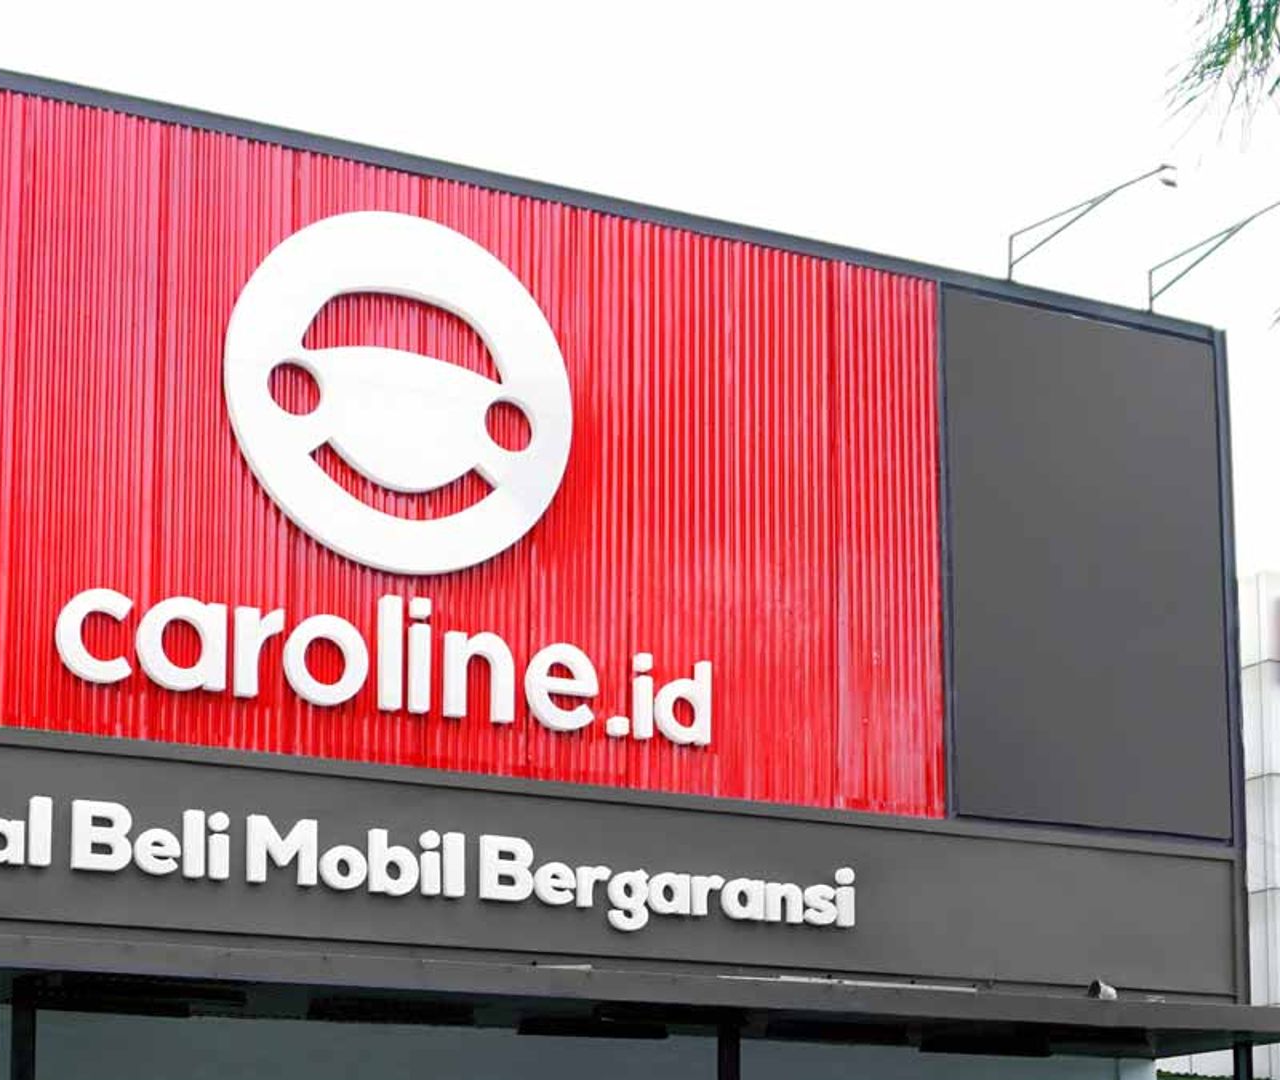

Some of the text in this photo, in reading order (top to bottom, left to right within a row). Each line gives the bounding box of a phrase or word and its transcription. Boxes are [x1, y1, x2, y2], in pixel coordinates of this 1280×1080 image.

[54, 587, 713, 747] caroline.id
[70, 797, 231, 882] Beli
[246, 814, 467, 900] Mobil
[478, 833, 857, 931] Bergaransi
